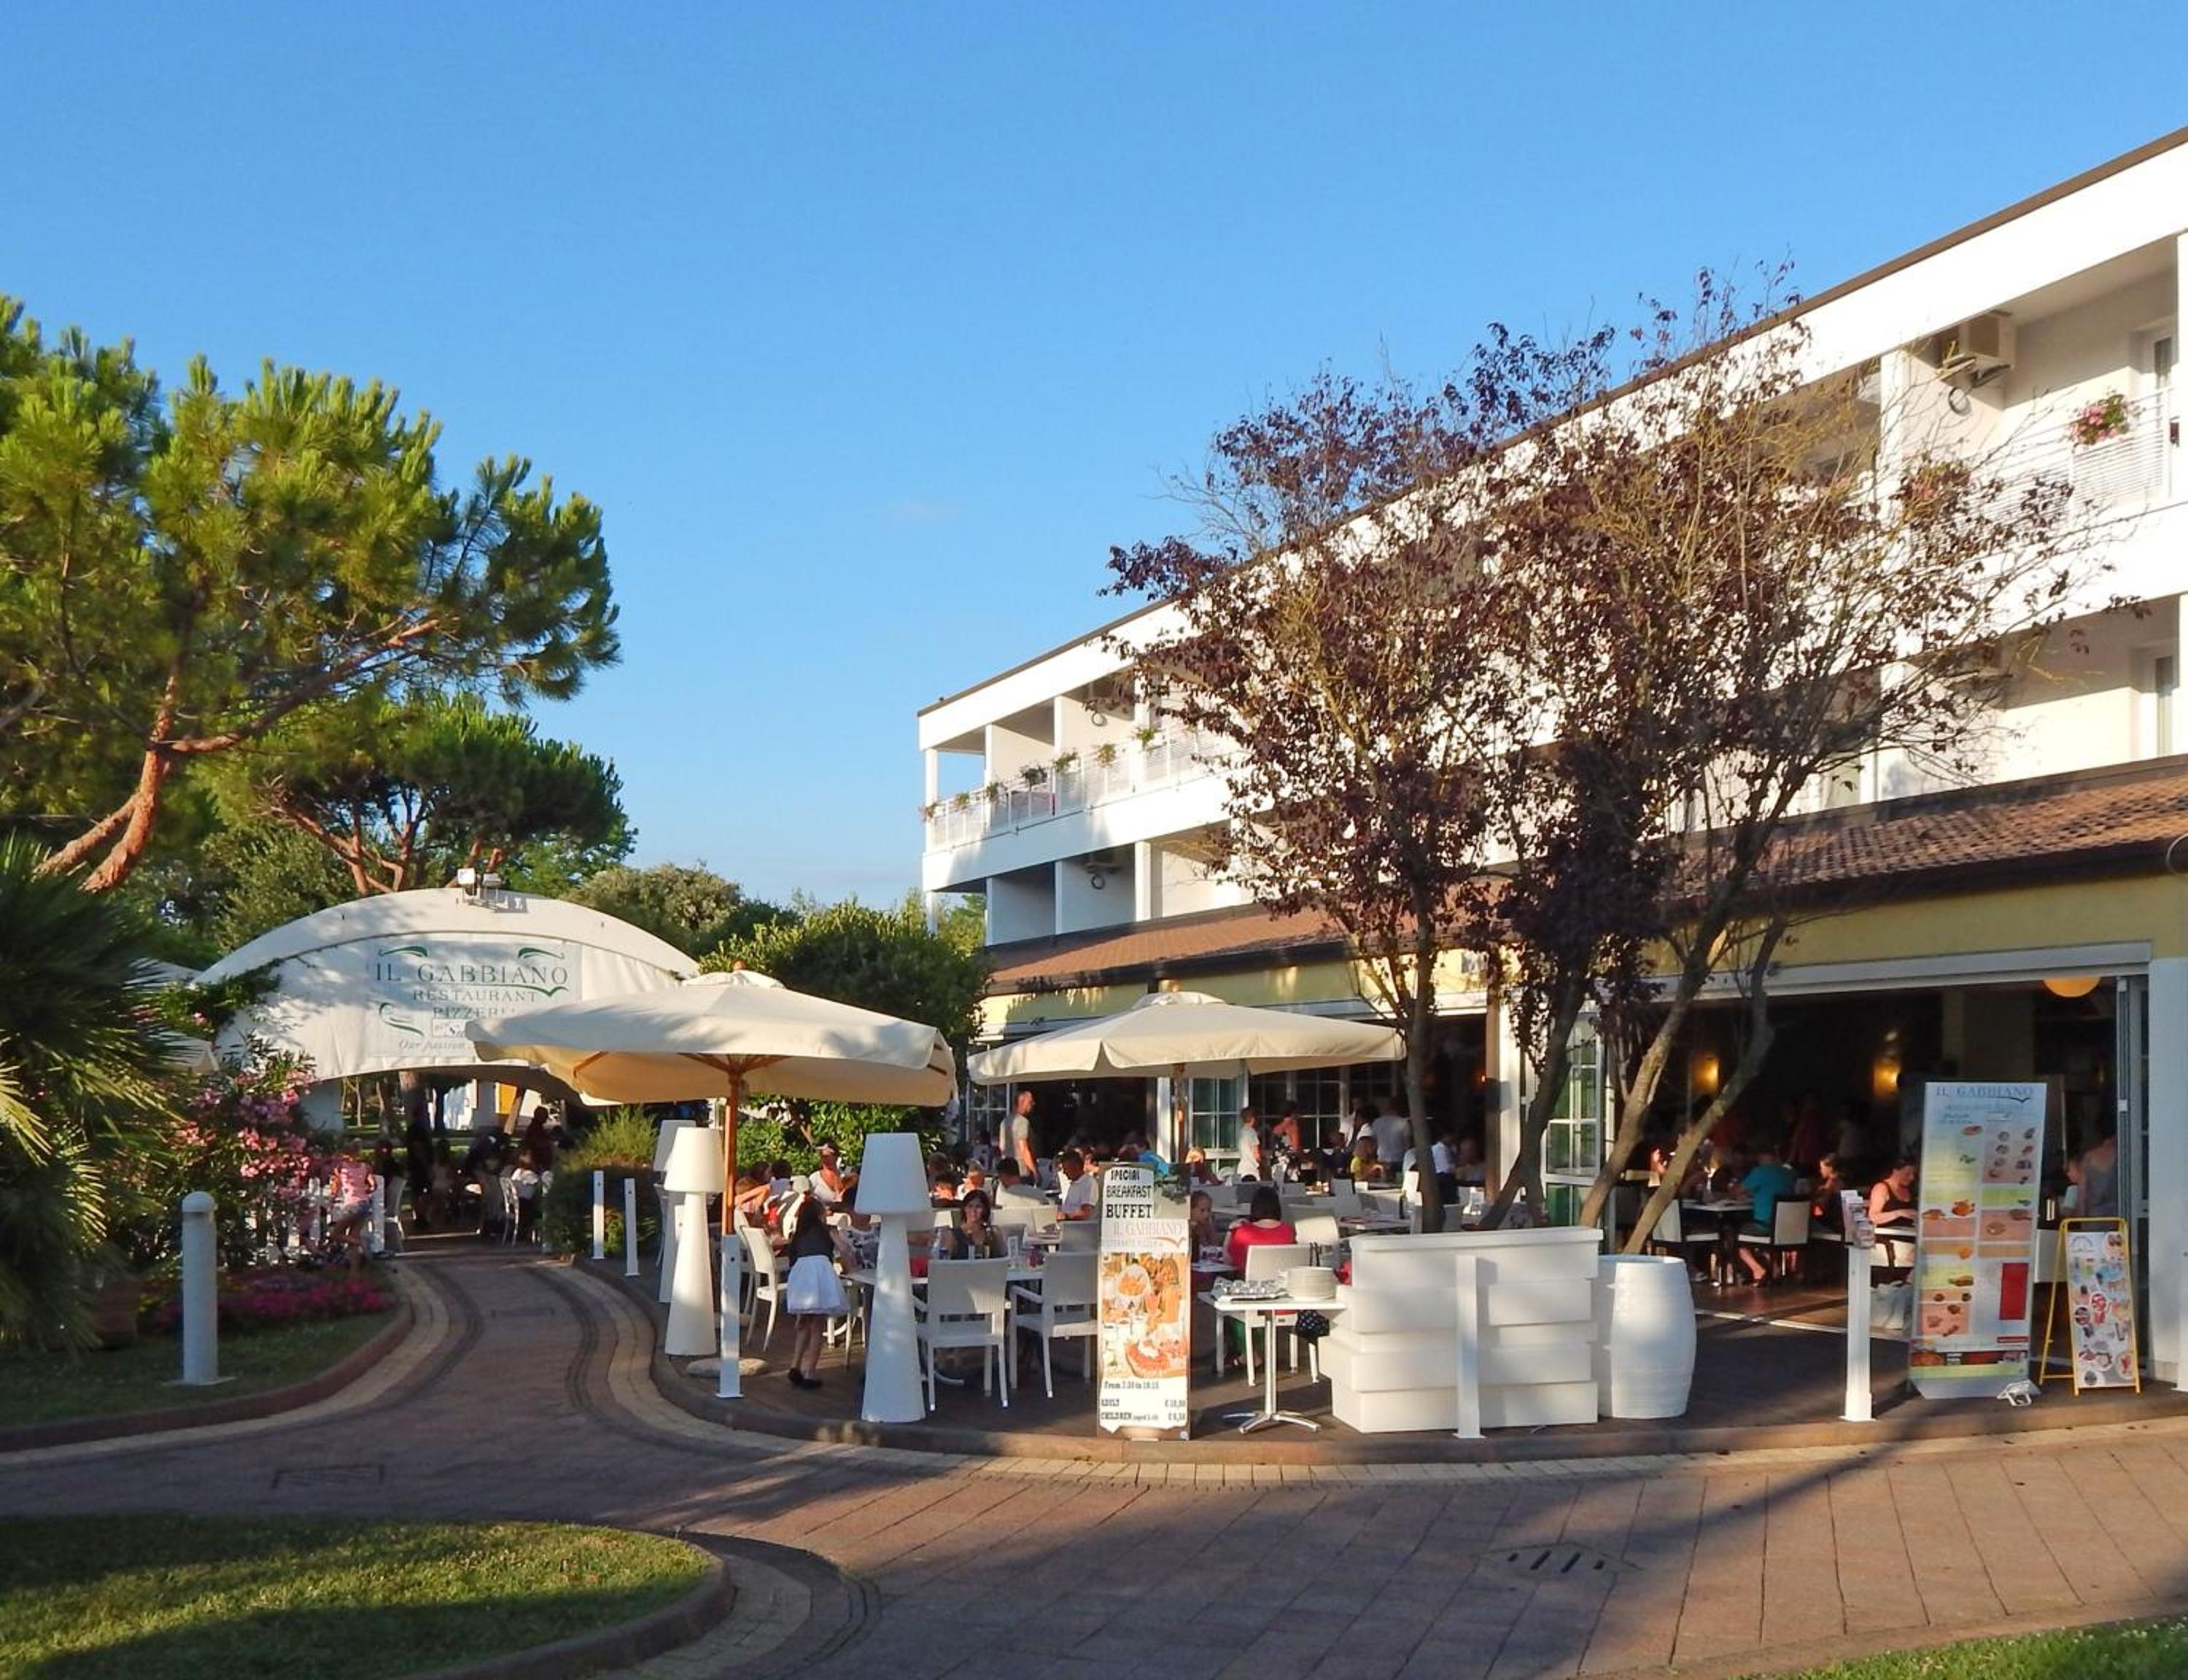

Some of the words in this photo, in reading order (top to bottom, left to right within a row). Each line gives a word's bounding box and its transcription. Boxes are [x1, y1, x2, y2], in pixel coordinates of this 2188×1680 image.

[376, 962, 400, 981] IL
[417, 963, 570, 984] GABBIANO
[414, 989, 538, 1003] RESTAURANT
[1936, 1085, 1949, 1096] IL
[1957, 1085, 2033, 1097] GABBIANO
[1111, 1170, 1140, 1181] SPECIAL
[1106, 1185, 1152, 1198] BREAKFAST
[1106, 1204, 1152, 1218] BUFFET
[1125, 1222, 1183, 1236] GABBIANO
[1101, 1412, 1132, 1420] CHILDREN
